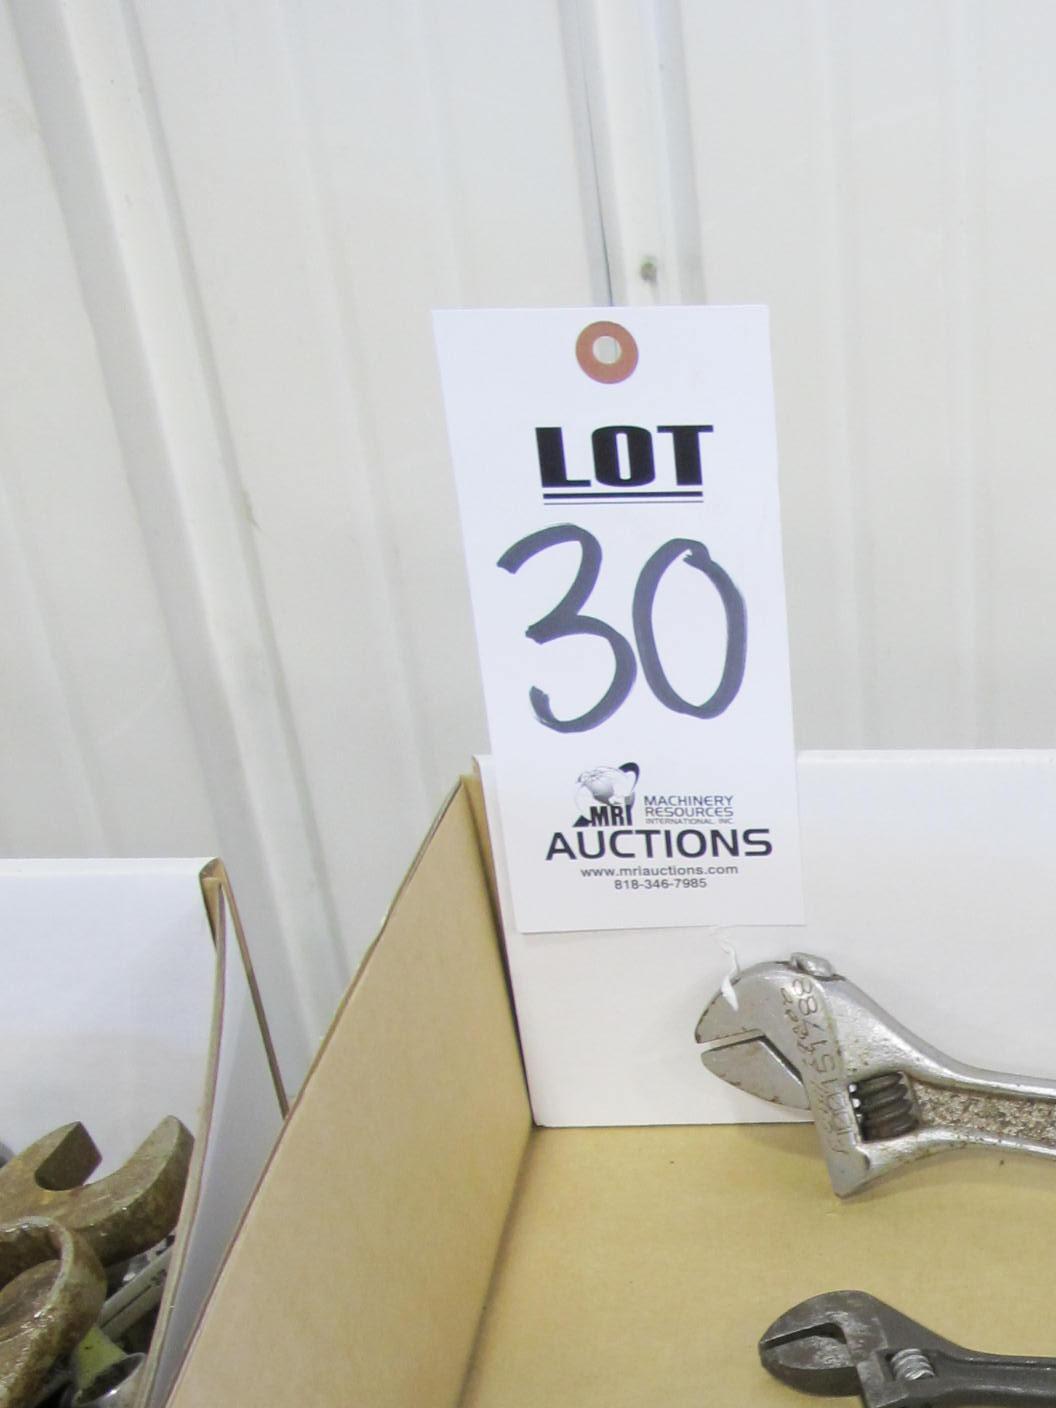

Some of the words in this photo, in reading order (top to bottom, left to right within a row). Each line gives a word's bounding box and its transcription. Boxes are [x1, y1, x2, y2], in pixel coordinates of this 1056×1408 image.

[536, 425, 714, 488] LOT
[497, 523, 748, 733] 30
[644, 795, 734, 806] MACHINERY
[589, 804, 634, 827] MRI
[645, 807, 734, 817] RESOURCES
[546, 829, 773, 860] AUCTIONS
[580, 864, 739, 877] www.mriauctions.com
[614, 878, 707, 890] 818-346-7985
